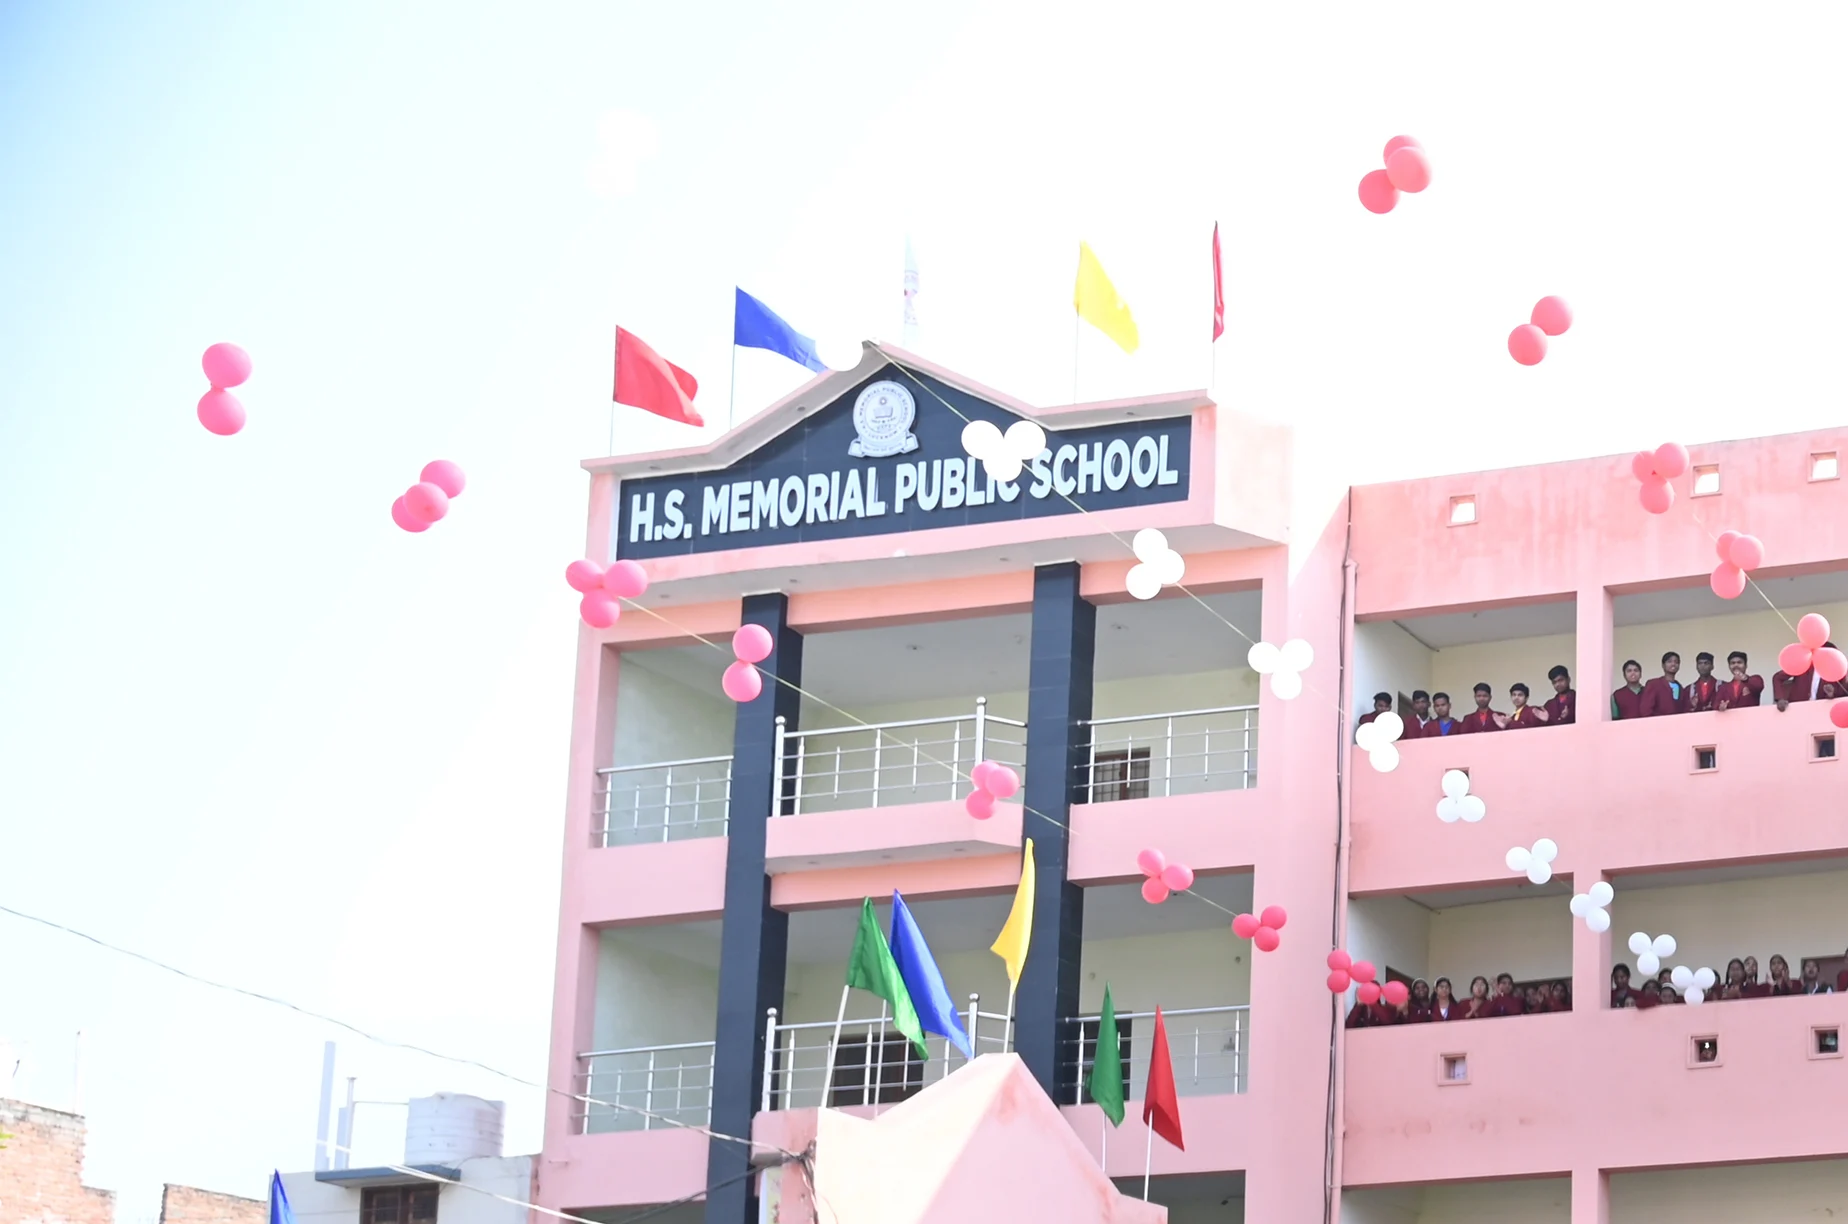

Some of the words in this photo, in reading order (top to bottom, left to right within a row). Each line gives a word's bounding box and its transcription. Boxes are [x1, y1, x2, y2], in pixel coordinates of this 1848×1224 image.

[629, 489, 692, 542] H.S.
[701, 467, 886, 535] MEMORIAL
[1029, 434, 1178, 499] SCHOOL
